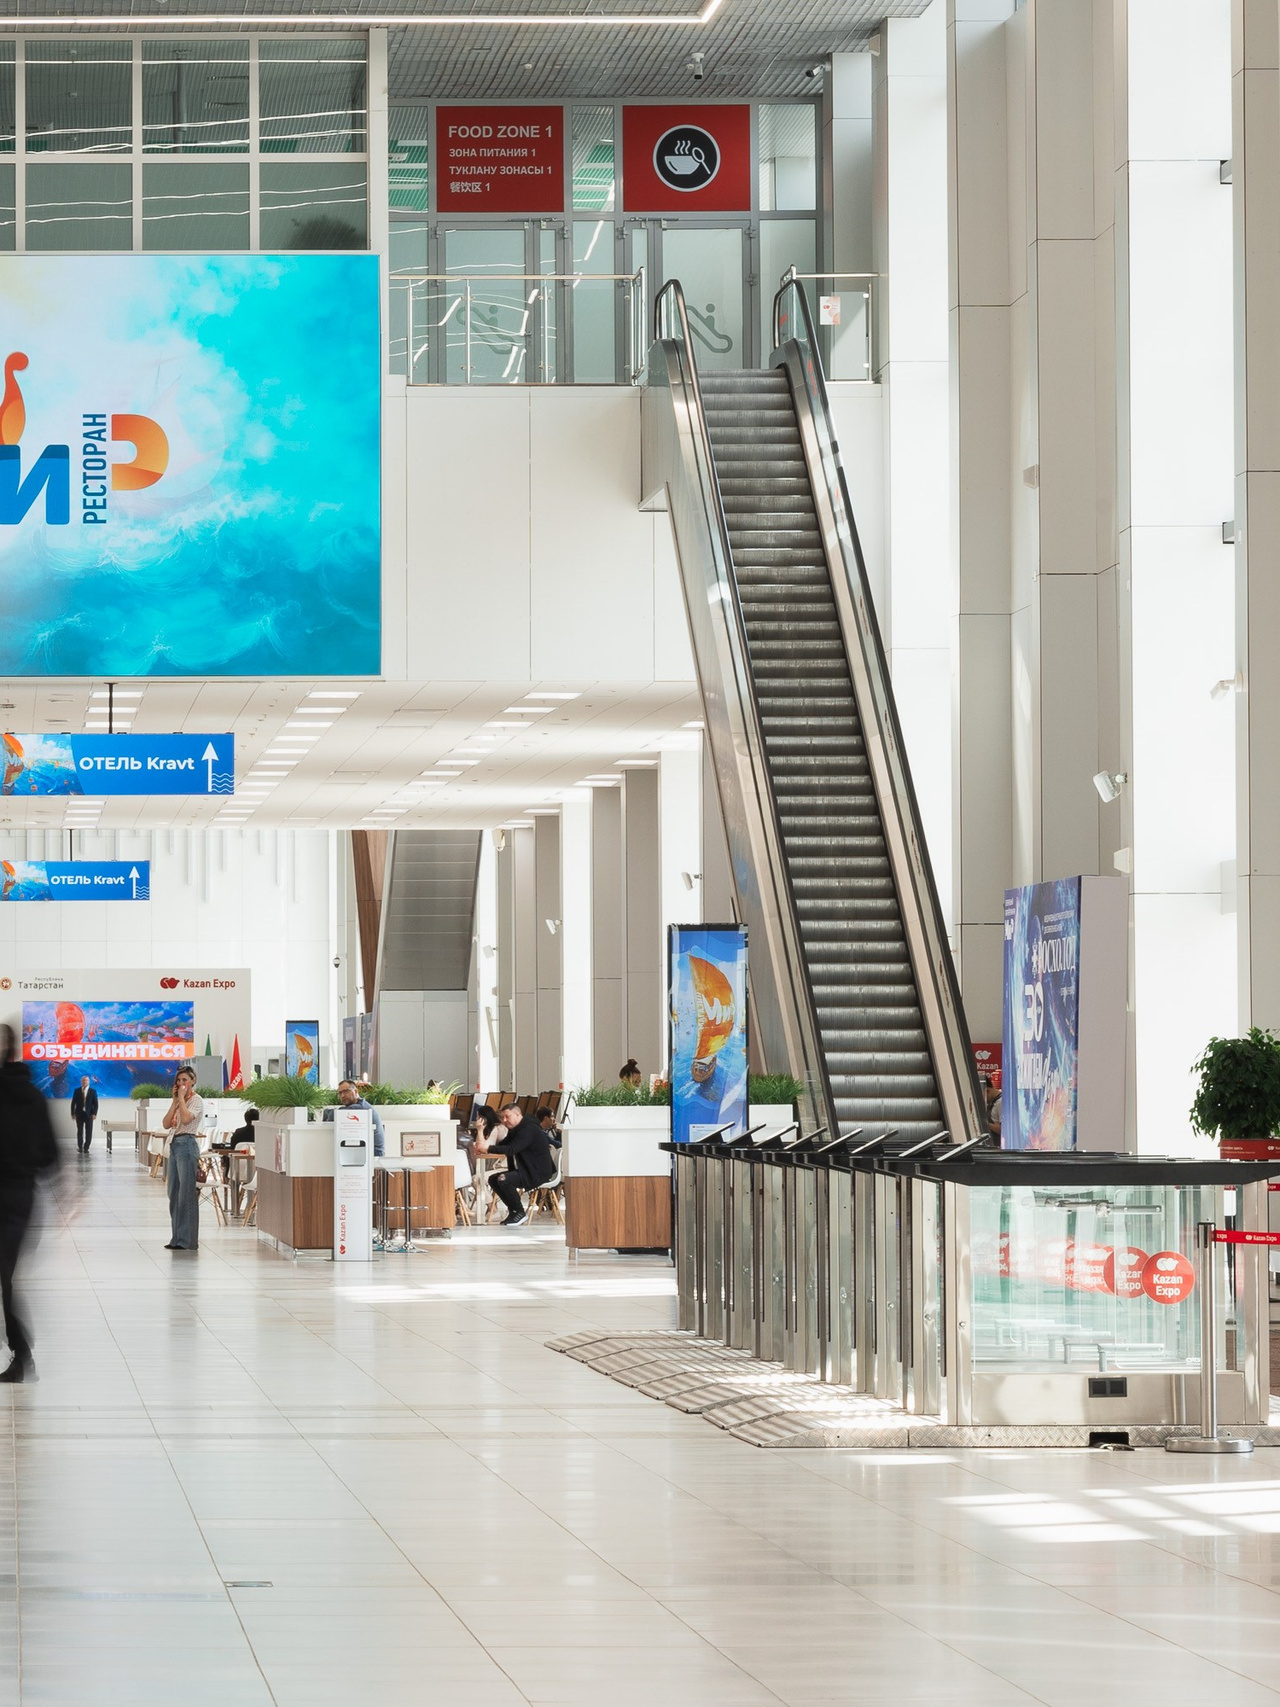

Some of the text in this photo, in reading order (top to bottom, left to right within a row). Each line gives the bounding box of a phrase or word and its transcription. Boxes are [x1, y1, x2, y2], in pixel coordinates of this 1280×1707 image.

[448, 126, 552, 138] FOOD ZONE 1
[449, 149, 536, 157] ЗОНА ПИТАНИЯ 1
[449, 166, 552, 175] ТУКЛАНУ ЗОНАСЫ 1
[450, 182, 490, 193] 餐饮区 1
[82, 413, 107, 524] РЕСТОРАН
[79, 757, 195, 770] ОТЕЛЬ Kravt
[50, 876, 125, 885] ОТЕЛЬ Kravt
[18, 981, 64, 990] Татарстан
[184, 979, 236, 990] Kazan Expo
[31, 1044, 185, 1059] ОБЪЕДИНЯТЬСЯ
[976, 1062, 998, 1070] Kazan
[339, 1204, 347, 1221] Expo
[1153, 1274, 1183, 1284] Kazan
[1117, 1282, 1141, 1292] Expo
[1155, 1286, 1181, 1298] Expo
